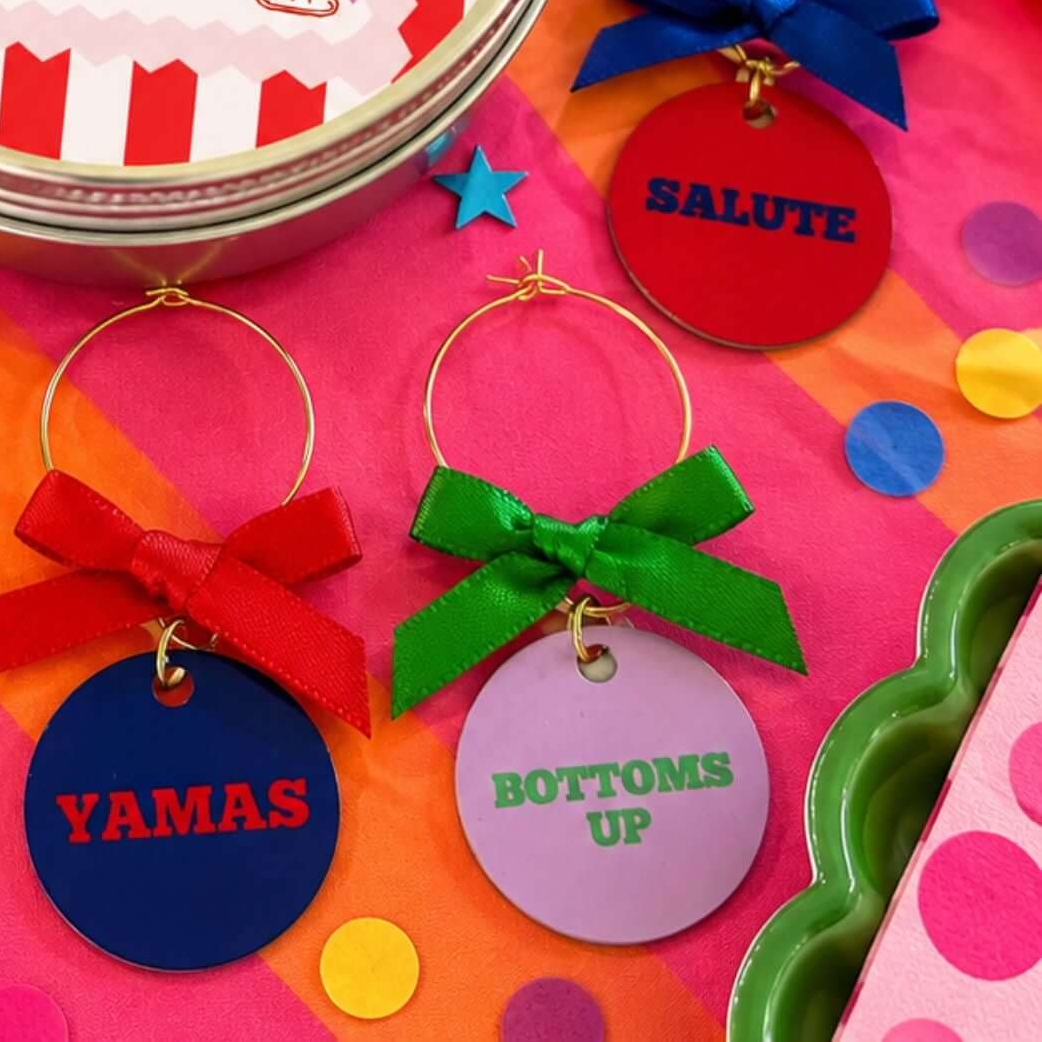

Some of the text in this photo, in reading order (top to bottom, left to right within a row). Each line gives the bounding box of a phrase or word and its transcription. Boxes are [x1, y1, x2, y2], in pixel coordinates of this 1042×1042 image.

[645, 177, 857, 244] SALUTE
[55, 777, 310, 844] YAMAS
[492, 751, 735, 810] BOTTOMS
[585, 806, 653, 848] UP
